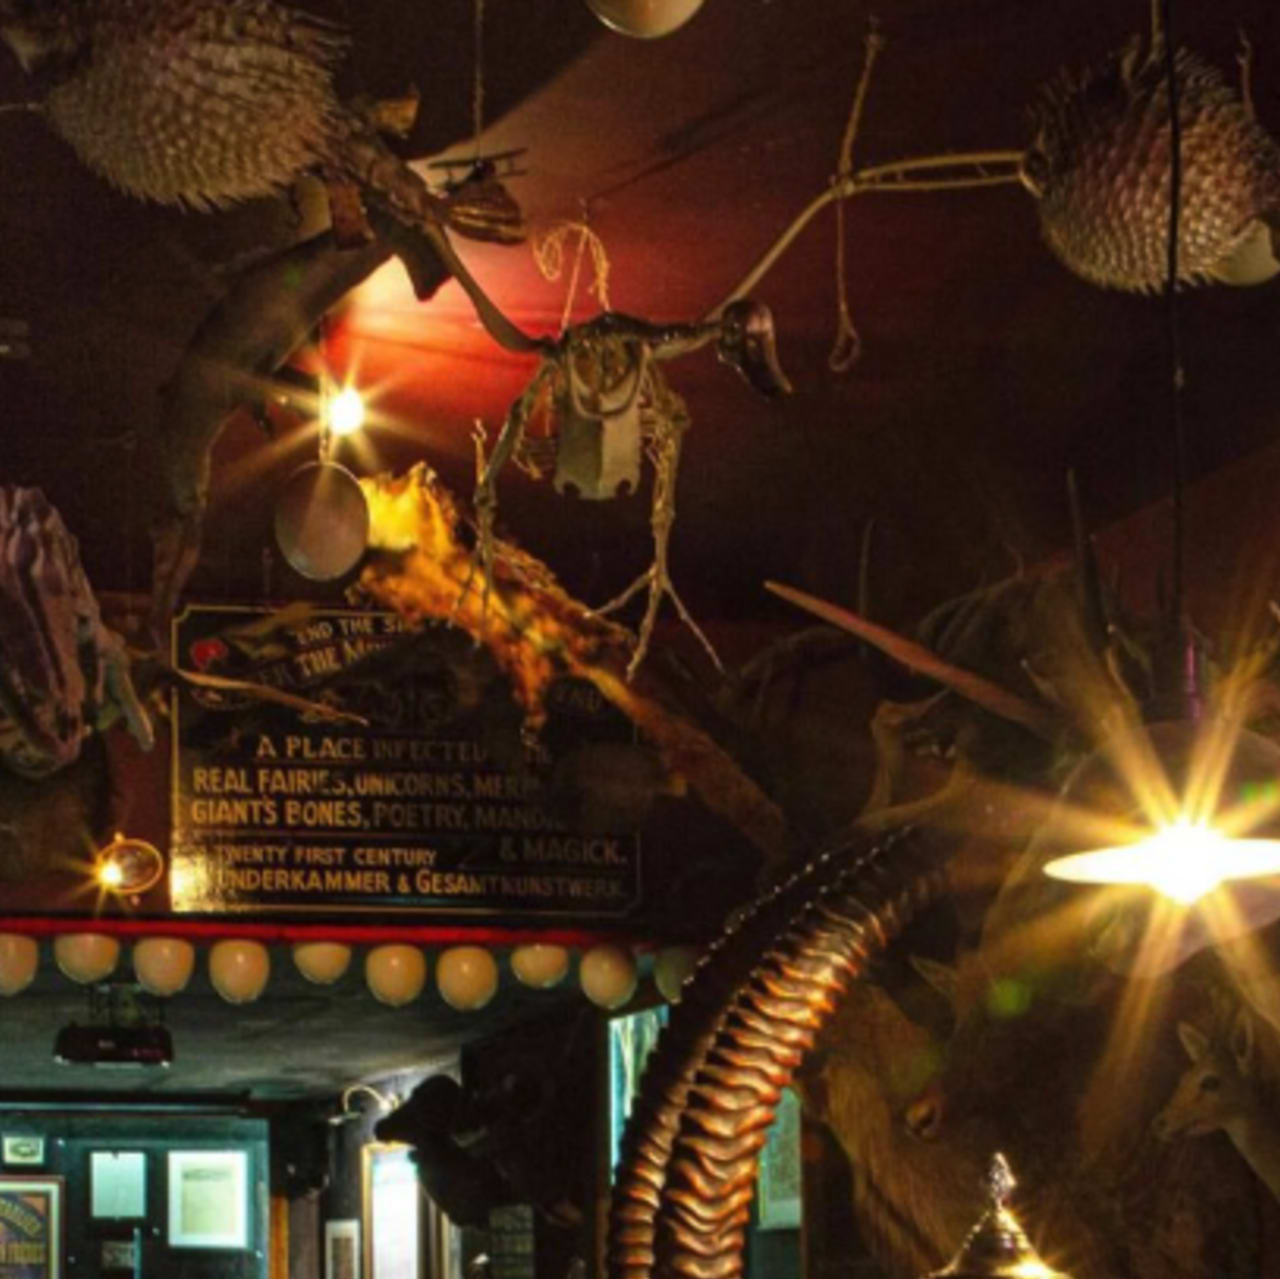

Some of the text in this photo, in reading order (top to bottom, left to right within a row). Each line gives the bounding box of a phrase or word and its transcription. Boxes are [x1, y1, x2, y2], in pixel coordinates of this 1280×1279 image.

[256, 735, 277, 758] A
[286, 735, 365, 759] PLACE
[192, 767, 252, 793] REAL
[285, 799, 369, 830] BONES,
[294, 848, 345, 866] FIRST
[353, 848, 437, 867] CENTURY
